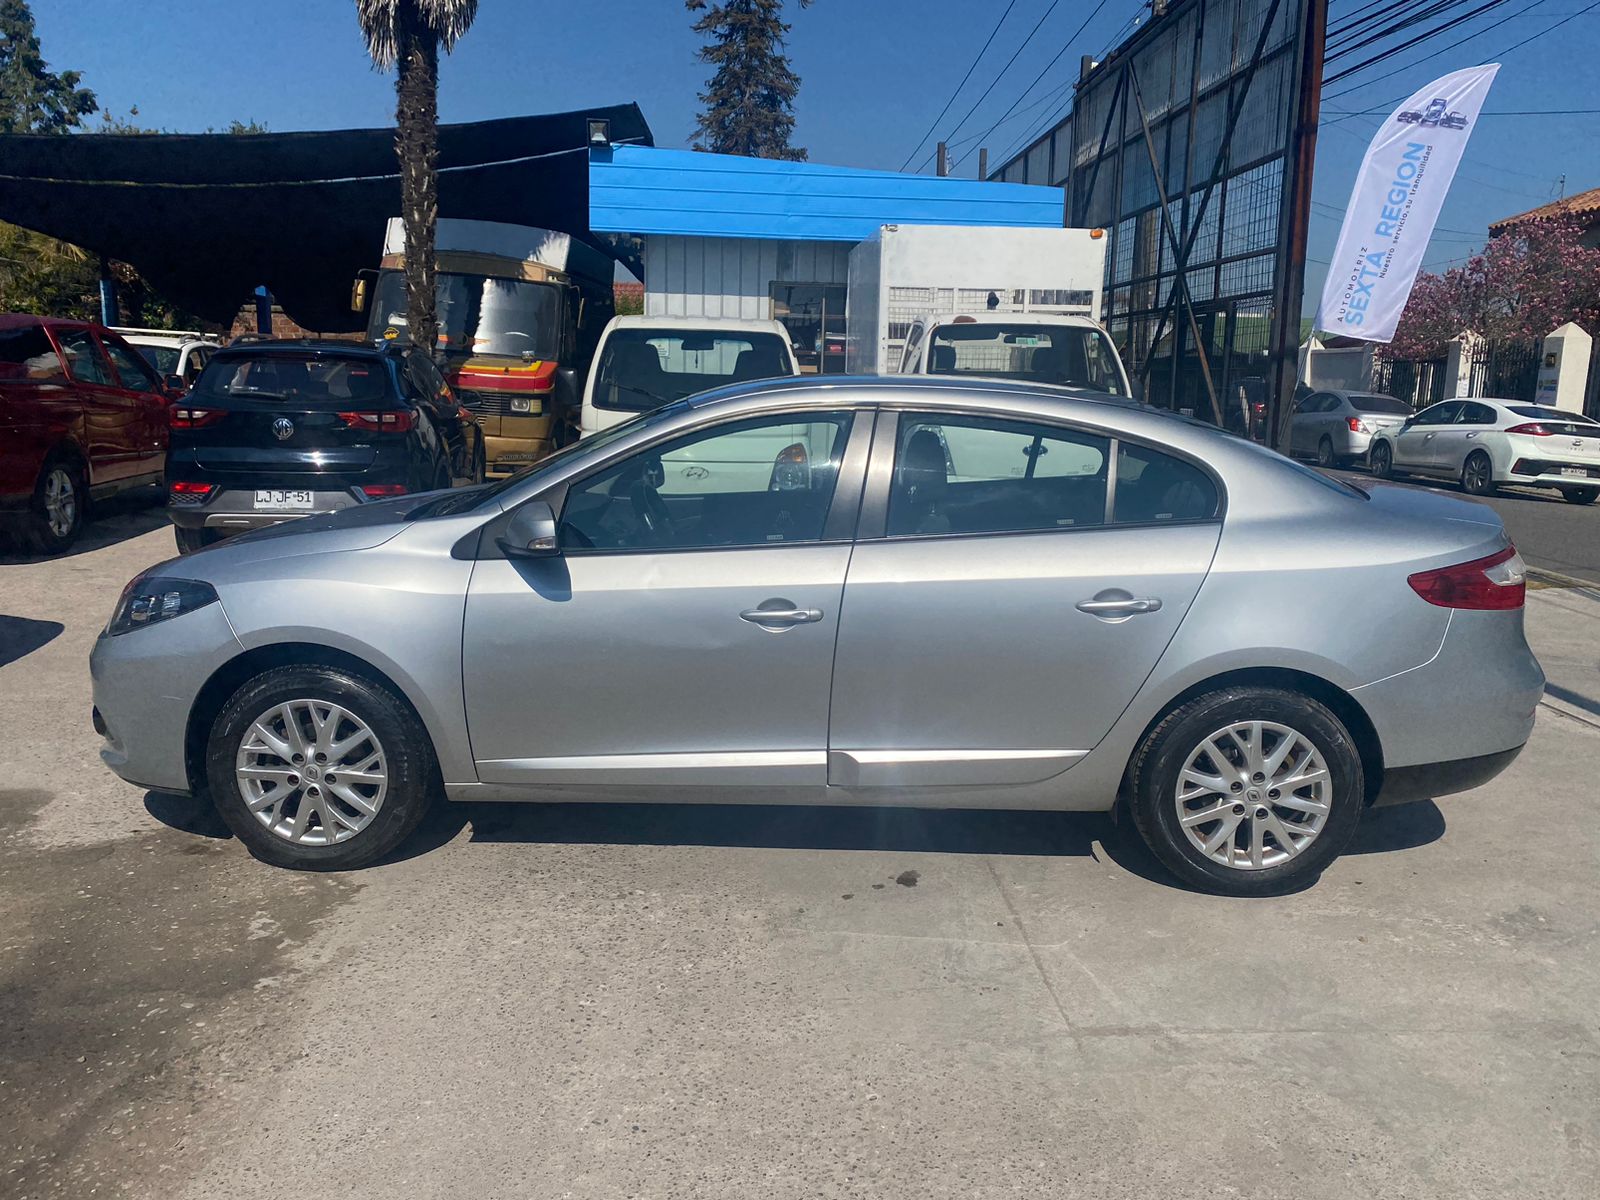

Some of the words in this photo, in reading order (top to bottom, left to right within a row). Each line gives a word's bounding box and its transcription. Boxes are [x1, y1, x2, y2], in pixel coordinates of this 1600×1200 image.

[1344, 251, 1387, 326] SEXTA
[1375, 142, 1426, 238] REGION
[1379, 247, 1395, 279] Nuestro
[1405, 199, 1413, 209] su
[1409, 145, 1433, 196] tranquilidad
[1337, 246, 1368, 322] AUTOMOTRIZ
